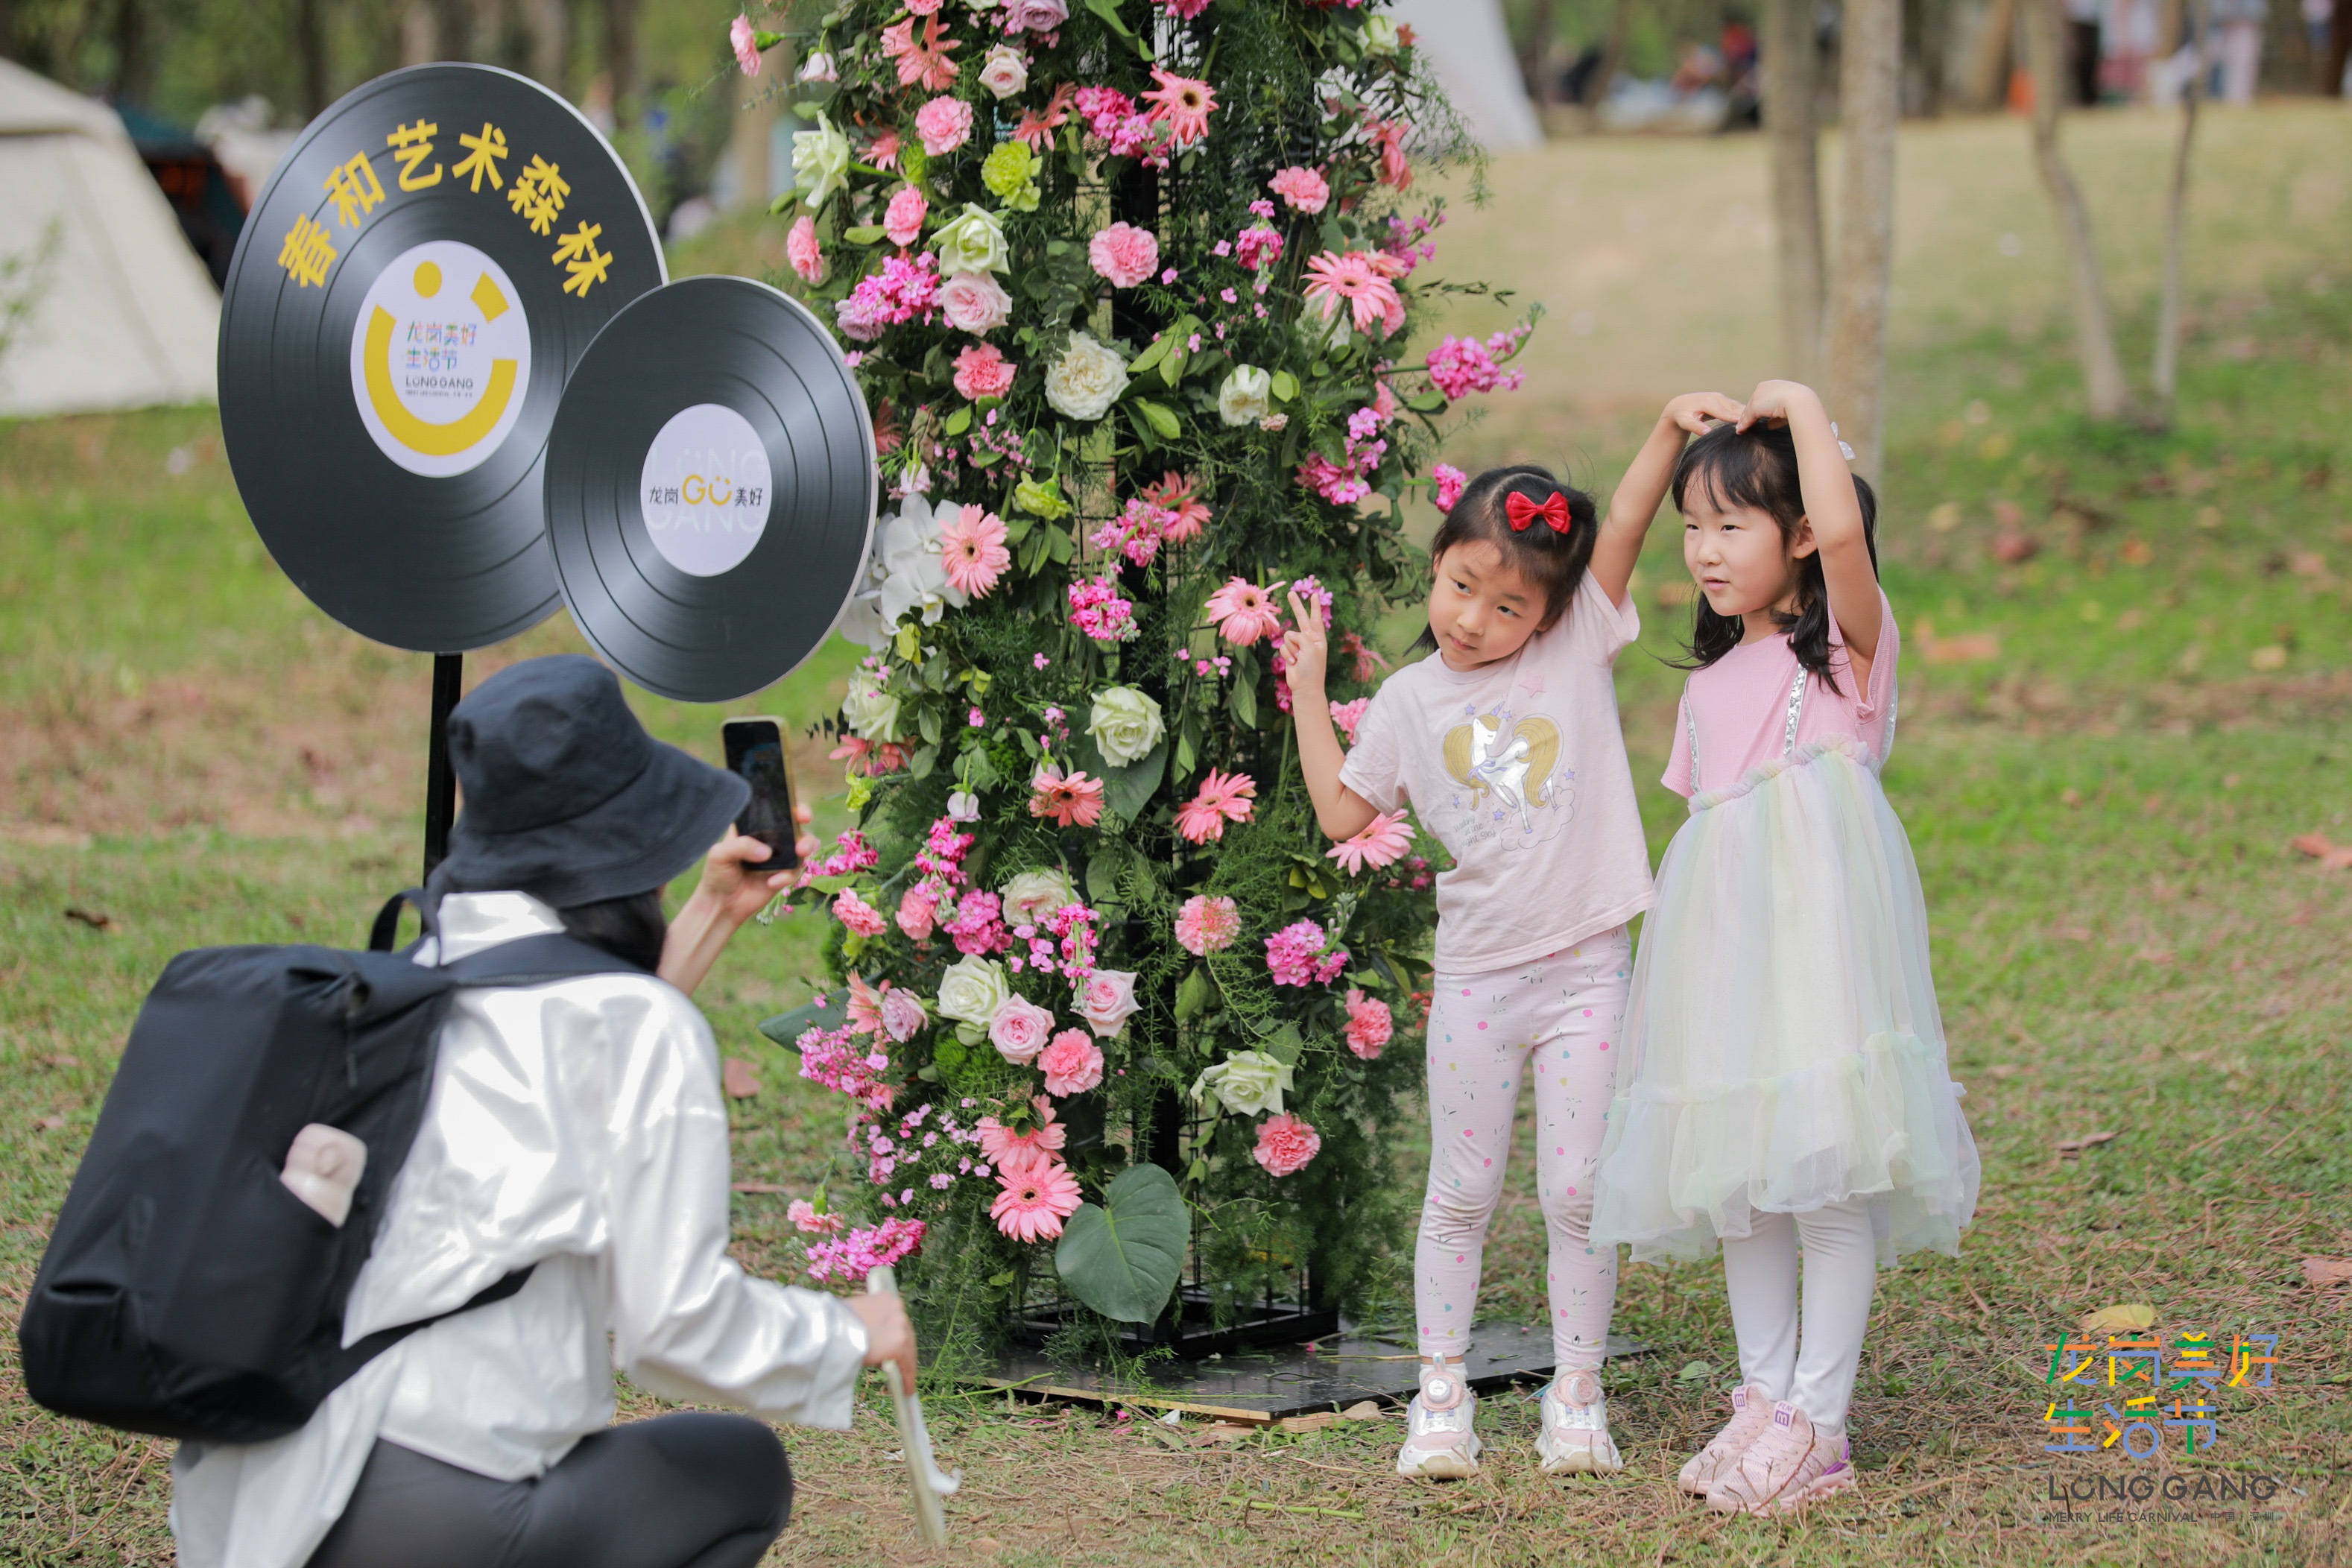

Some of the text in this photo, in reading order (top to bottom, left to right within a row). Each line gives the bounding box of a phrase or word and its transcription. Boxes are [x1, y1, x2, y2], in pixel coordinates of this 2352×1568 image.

[277, 118, 613, 298] 春和艺术森林
[407, 320, 477, 346] 龙岗美好
[405, 346, 458, 371] 生活节
